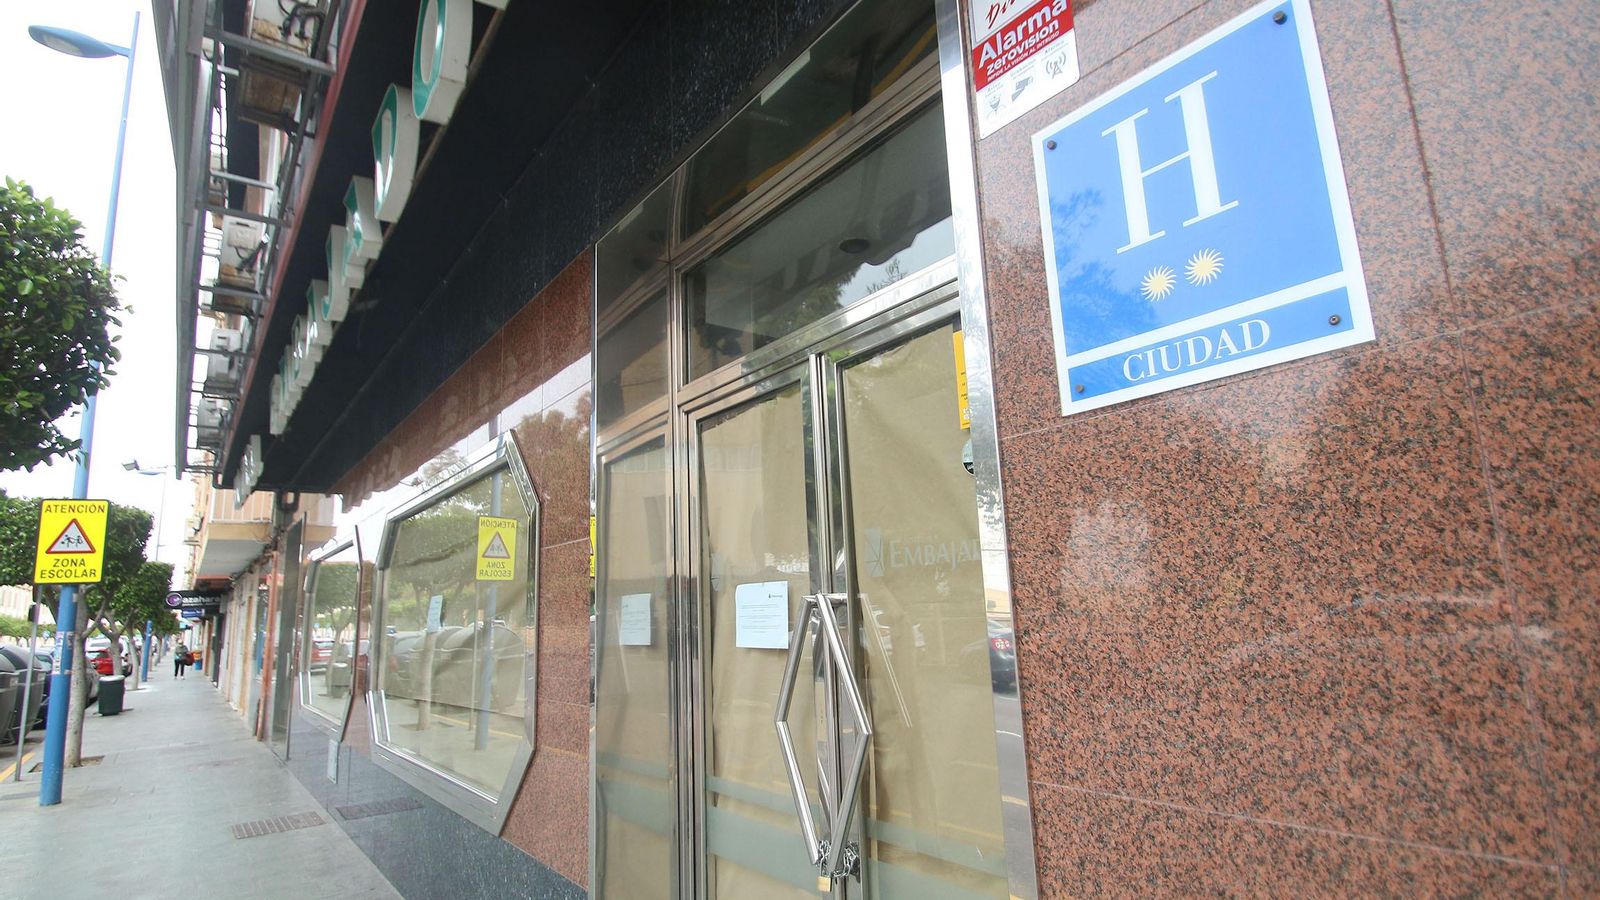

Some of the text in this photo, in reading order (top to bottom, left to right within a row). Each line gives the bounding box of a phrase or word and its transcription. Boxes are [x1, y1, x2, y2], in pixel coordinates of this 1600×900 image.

[978, 0, 1067, 69] Alarma
[986, 19, 1059, 76] zerovision
[1101, 71, 1239, 254] H
[1123, 319, 1271, 382] CIUDAD
[40, 569, 97, 579] ESCOLAR
[53, 559, 86, 567] ZONA
